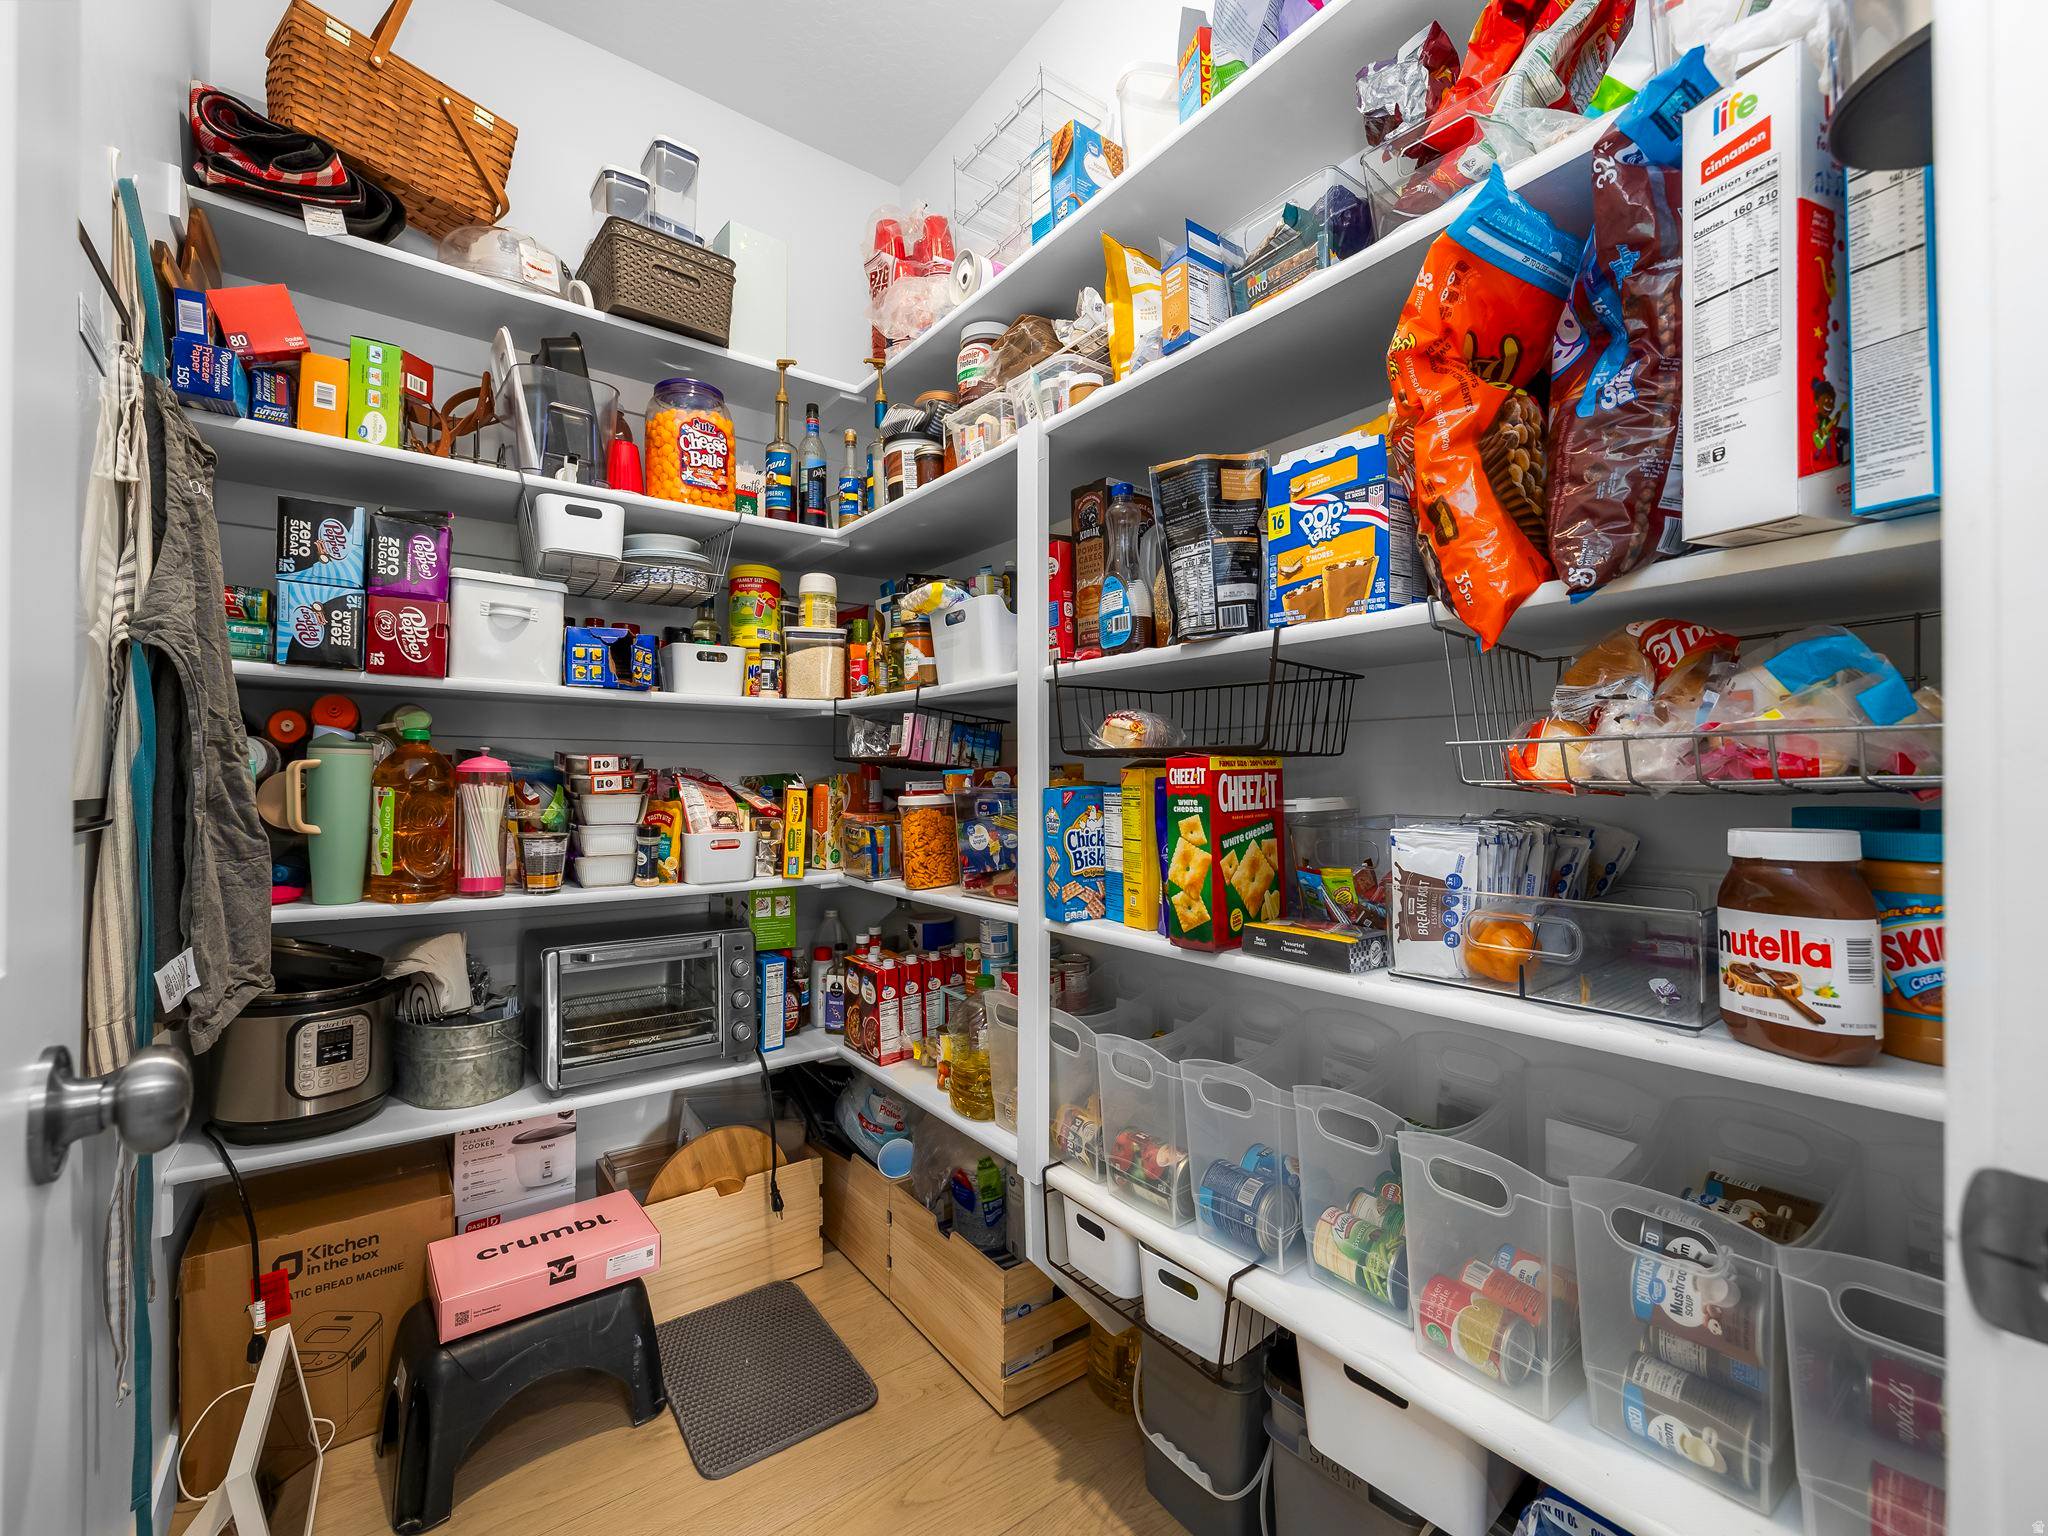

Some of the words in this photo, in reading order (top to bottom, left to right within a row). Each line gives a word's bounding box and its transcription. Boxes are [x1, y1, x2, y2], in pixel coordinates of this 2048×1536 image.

[1713, 91, 1758, 137] life
[1704, 130, 1766, 177] cinnamon
[1694, 175, 1741, 206] Nutrition
[1745, 157, 1778, 178] Facts
[1693, 219, 1724, 239] Calories
[1734, 202, 1752, 217] 160
[1758, 189, 1778, 206] 210
[870, 267, 889, 287] BIG
[1247, 280, 1268, 298] KIND
[230, 335, 247, 346] 80
[192, 344, 202, 373] Paper
[202, 347, 212, 383] Freezer
[220, 351, 232, 387] Reynolds
[177, 365, 189, 384] 150
[680, 432, 727, 456] Cheese
[689, 450, 724, 468] Balls
[1369, 485, 1383, 495] USA
[1080, 526, 1100, 540] KODIAK
[1272, 514, 1285, 530] 16
[290, 519, 299, 555] SUGAR
[300, 520, 312, 557] zero
[323, 522, 342, 558] Pepper
[378, 536, 387, 575] SUGAR
[388, 538, 400, 576] zero
[412, 539, 432, 578] Pepper
[1077, 543, 1102, 556] POWER
[1306, 550, 1334, 563] S'MORES
[283, 557, 295, 573] 12
[346, 595, 357, 609] 12
[331, 610, 342, 646] zero
[342, 611, 352, 647] SUGAR
[381, 618, 391, 630] 23
[399, 611, 423, 659] Pepper
[416, 624, 429, 647] Dr
[374, 651, 385, 666] 12
[648, 814, 661, 823] TASTY
[1173, 805, 1203, 814] CHEDDAR
[1066, 831, 1104, 851] Chick
[1222, 833, 1244, 849] WHITE
[1245, 822, 1274, 840] CHEDDAR
[1072, 849, 1104, 871] Bisk
[1418, 880, 1430, 935] BREAKFAST
[1905, 905, 1929, 916] the
[1719, 928, 1832, 968] nutella
[318, 1021, 339, 1030] Instant
[628, 1035, 661, 1045] PowerXL
[879, 1104, 901, 1120] Plates
[462, 1140, 495, 1151] COOKER
[1065, 1114, 1083, 1163] PEARL
[467, 1222, 486, 1232] DASH
[307, 1233, 380, 1261] Kitchen
[307, 1264, 320, 1276] in
[324, 1256, 348, 1273] the
[351, 1249, 379, 1264] box
[315, 1276, 354, 1295] BREAD
[356, 1262, 405, 1282] MACHINE
[1685, 1295, 1694, 1317] SOUP
